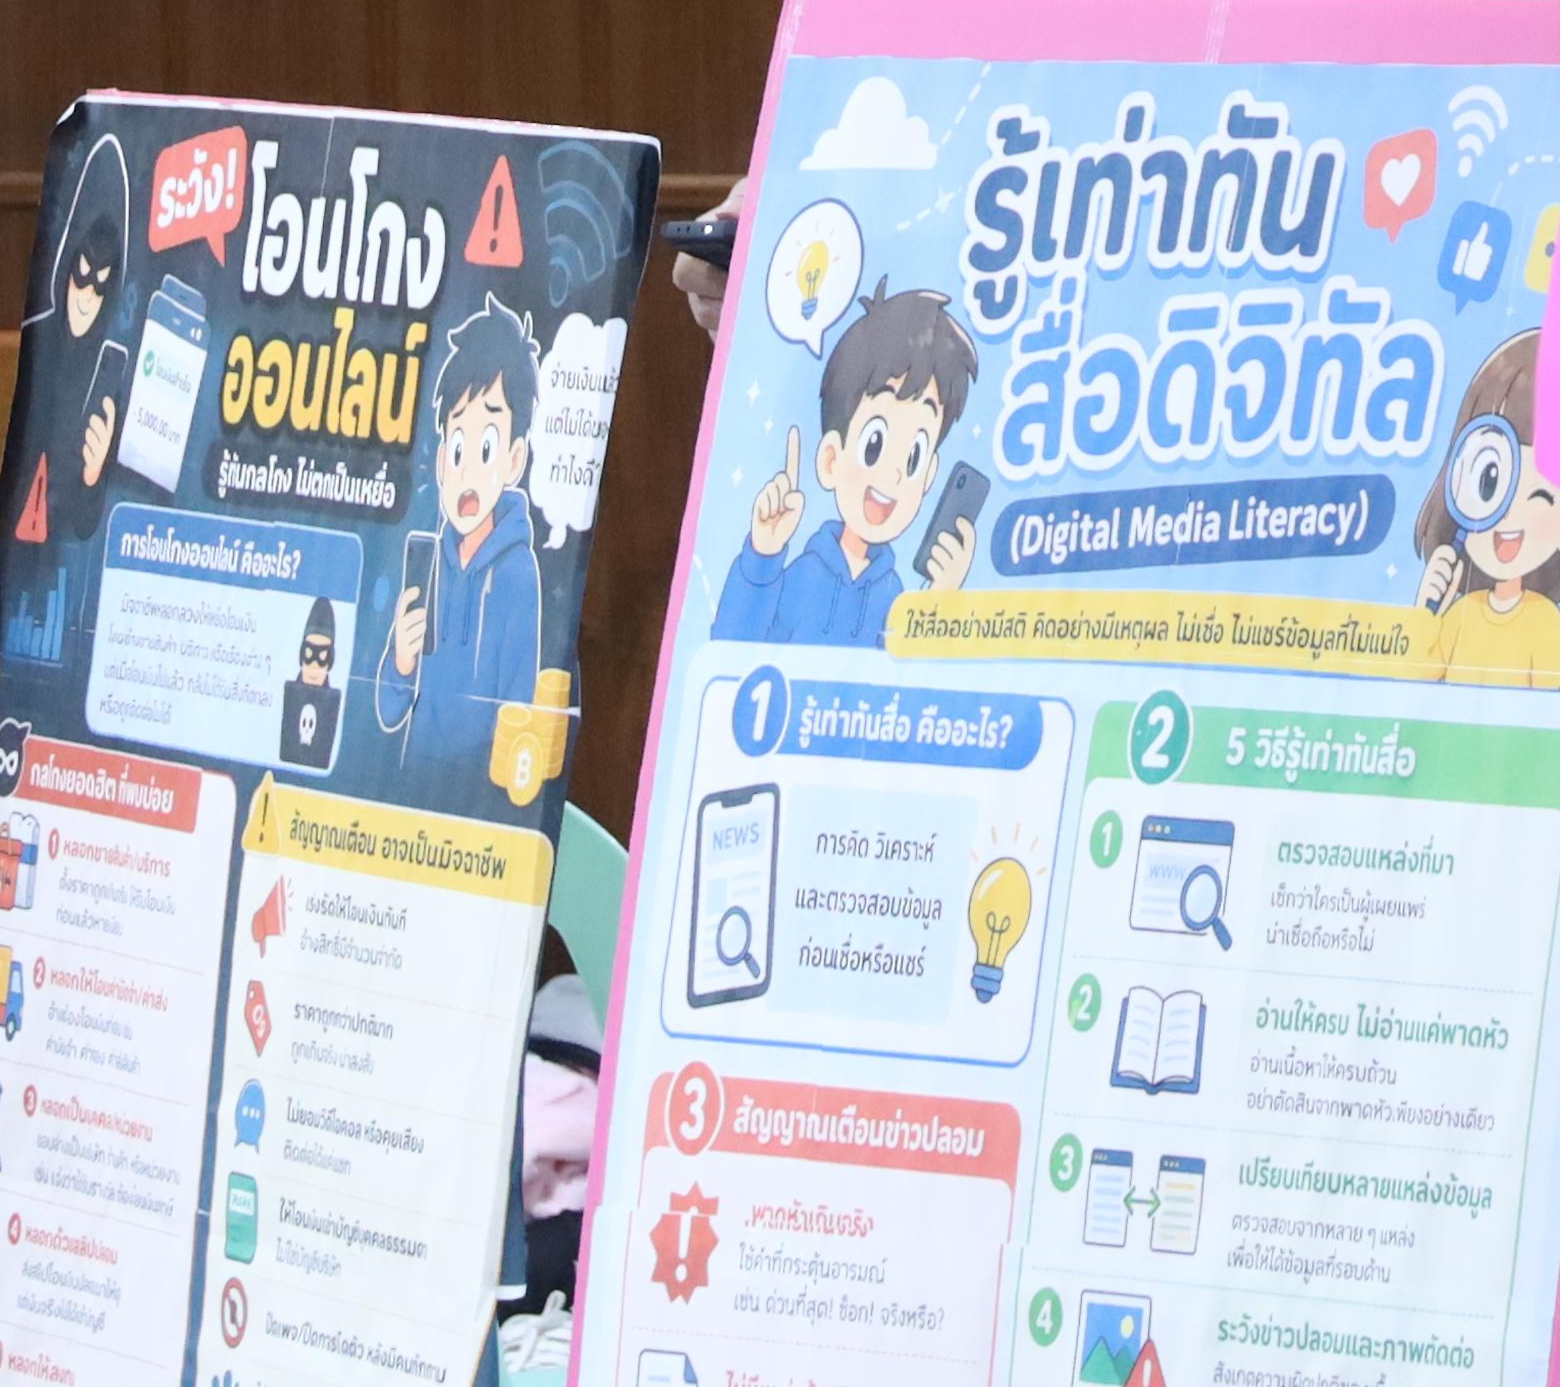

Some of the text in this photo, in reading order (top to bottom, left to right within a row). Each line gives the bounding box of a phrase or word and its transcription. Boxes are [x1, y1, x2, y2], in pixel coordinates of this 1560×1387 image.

[156, 147, 238, 229] ระวัง!
[967, 98, 1336, 321] รู้เท่าทัน
[242, 139, 447, 311] โอนโกง
[221, 308, 429, 445] ออนไลน์
[1001, 275, 1437, 475] สื่อดิจิทัล
[219, 449, 396, 510] รู้ทันกลโกง ไม่ตกเป็นเหยื่อ
[549, 455, 601, 487] ทำไงดี
[120, 524, 302, 580] การโอนโกงออนไลน์ คืออะไร?
[1010, 490, 1370, 566] (Digital Media Literacy)
[905, 605, 1411, 661] ใช้สื่ออย่างมีสติ คิดอย่างมีเหตุผล ไม่เชื่อ ไม่แชร์ข้อมูลที่ไม่แน่ใจ
[750, 679, 773, 743] 1
[799, 692, 1014, 750] รู้เท่าทันสื่อ คืออะไร?
[1141, 704, 1177, 770] 2
[1226, 722, 1417, 784] 5 วิธีรู้เท่าทันสื่อ
[30, 752, 175, 814] กลโกงยอดฮิต ที่พบบ่อย
[289, 811, 507, 881] สัญญาณเตือน อาจเป็นมิจฉาชีพ
[712, 822, 760, 852] NEWS
[816, 829, 937, 863] การคิด วิเคราะห์
[1101, 821, 1113, 858] 1
[1277, 835, 1455, 876] ตรวจสอบแหล่งที่มา
[795, 885, 942, 931] และตรวจสอบข้อมูล
[798, 933, 926, 978] ก่อนเชื่อหรือแชร์
[1266, 921, 1375, 954] น่าเชื่อถือหรือไม่
[1078, 983, 1093, 1021] 2
[1255, 1000, 1509, 1050] อ่านให้ครบ ไม่อ่านแค่พาดหัว
[1250, 1045, 1397, 1086] อ่านเนื้อหาให้ครบถ้วน
[678, 1076, 706, 1141] 3
[733, 1095, 986, 1158] สัญญาณเตือนข่าวปลอม
[1056, 1144, 1075, 1181] 3
[1238, 1156, 1493, 1220] เปรียบเทียบหลายแหล่งข้อมูล
[1231, 1212, 1363, 1243] ตรวจสอบจากหลาย
[1380, 1224, 1416, 1249] แหล่ง
[739, 1240, 888, 1286] ใช้คำที่กระตุ้นอารมณ์
[1226, 1239, 1391, 1285] เพื่อให้ได้ข้อมูลที่รอบด้าน
[734, 1288, 760, 1314] เช่น
[765, 1285, 834, 1328] ด่วนที่สุด!
[881, 1301, 945, 1331] จริงหรือ?
[1036, 1297, 1053, 1336] 4
[1217, 1312, 1475, 1370] ระวังข่าวปลอมและภาพตัดต่อ
